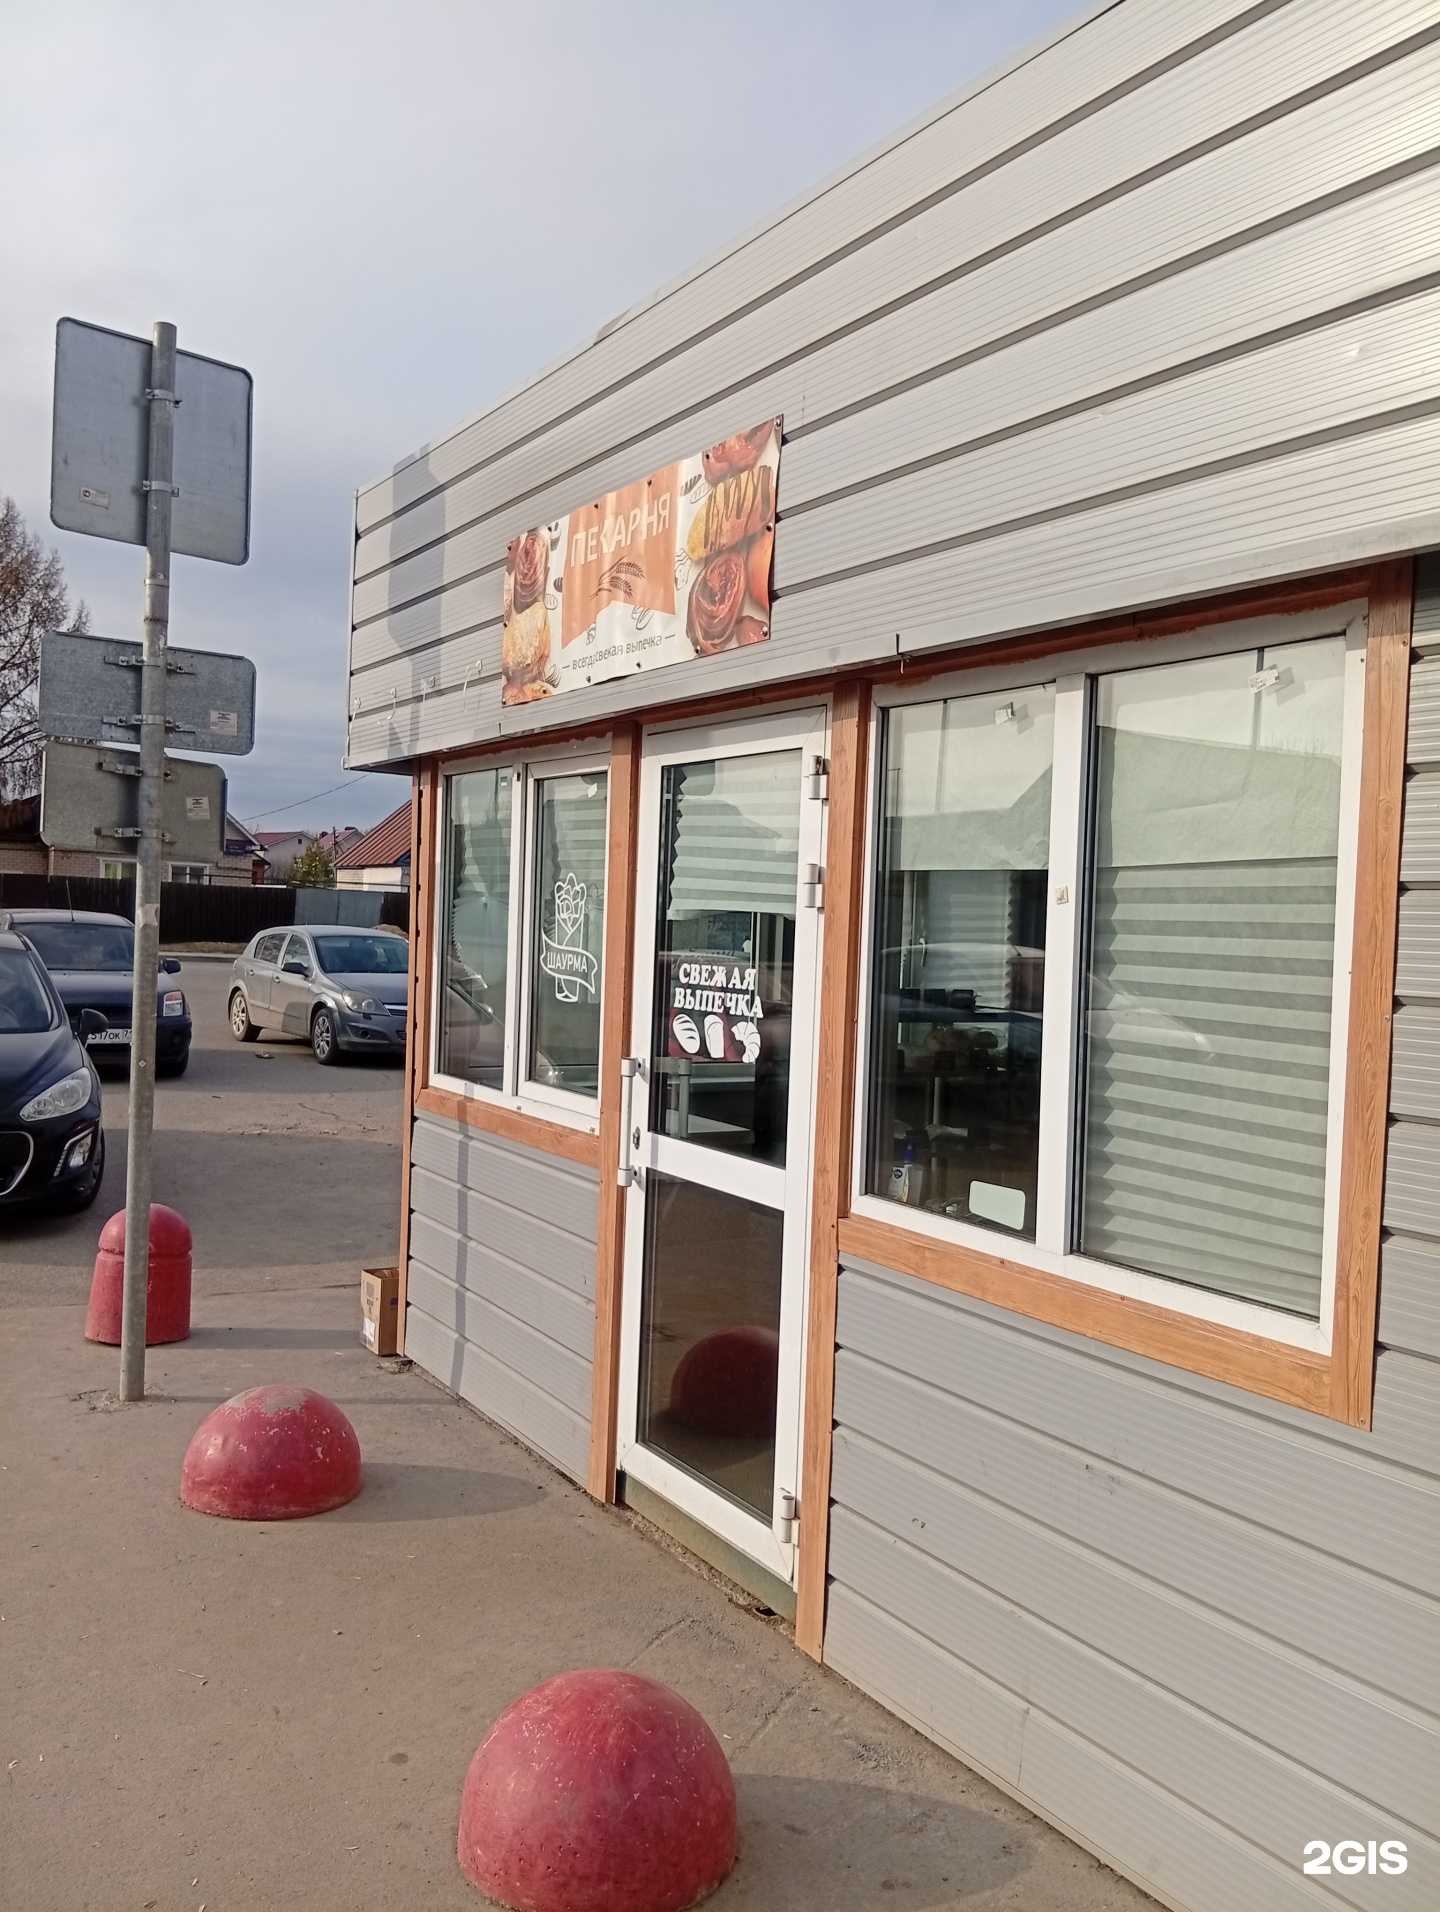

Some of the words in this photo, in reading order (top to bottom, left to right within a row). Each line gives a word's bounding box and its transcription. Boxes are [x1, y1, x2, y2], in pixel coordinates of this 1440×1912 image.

[547, 951, 588, 973] ШАУРМА
[678, 963, 758, 991] СВЕЖАЯ
[673, 987, 764, 1018] ВЫПЕЧКА
